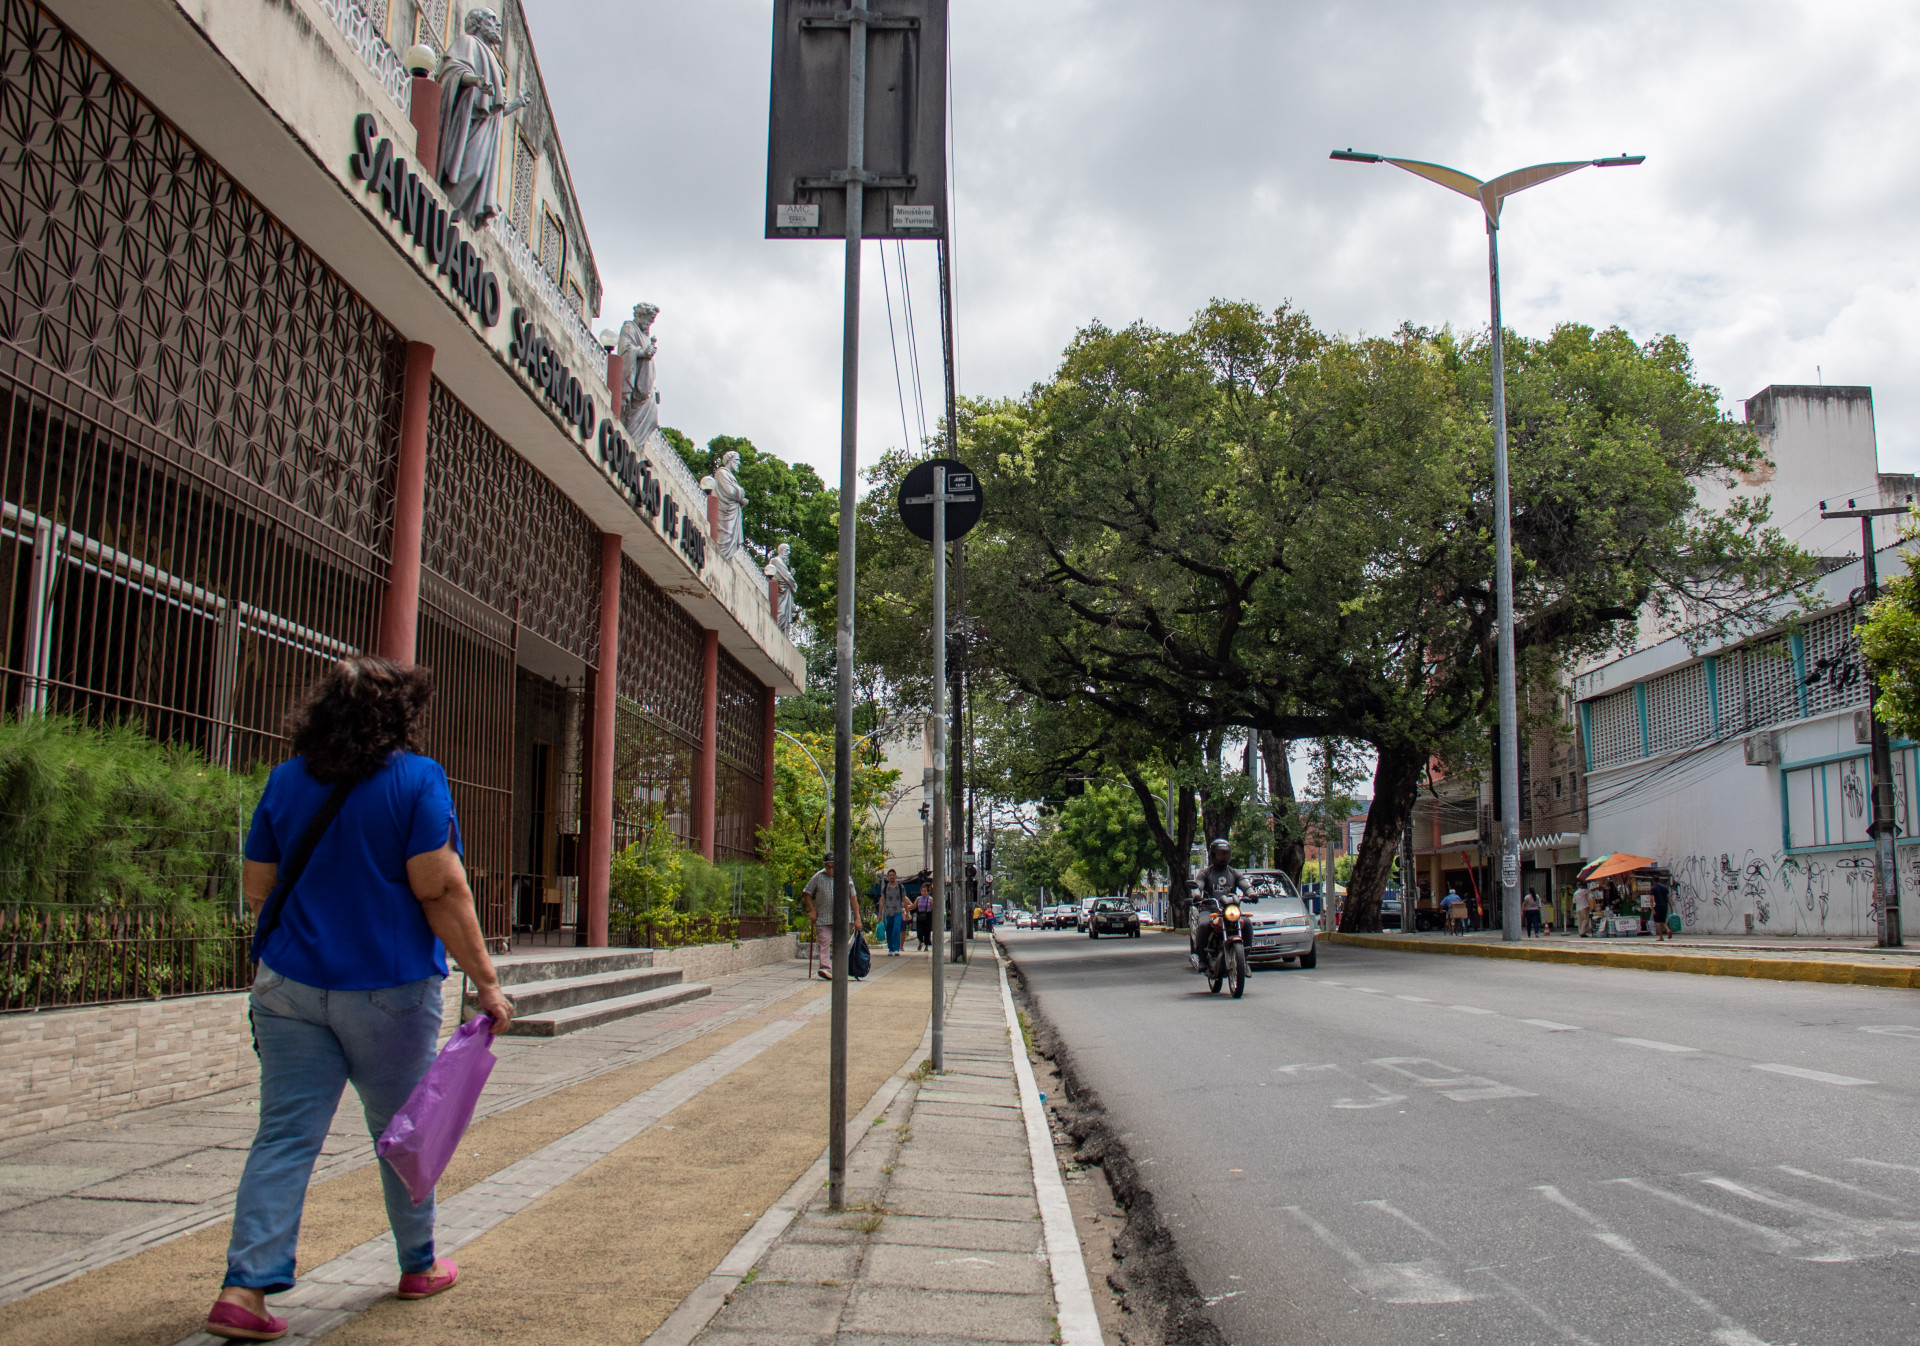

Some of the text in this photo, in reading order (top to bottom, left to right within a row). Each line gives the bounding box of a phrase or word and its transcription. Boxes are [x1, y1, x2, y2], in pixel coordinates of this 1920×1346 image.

[896, 207, 932, 216] Ministério
[893, 217, 934, 225] do Turismo
[352, 113, 500, 328] SANTUÁRIO
[509, 306, 596, 440] SAGRADO
[599, 418, 662, 518] CORAÇÃO
[664, 494, 679, 540] DE
